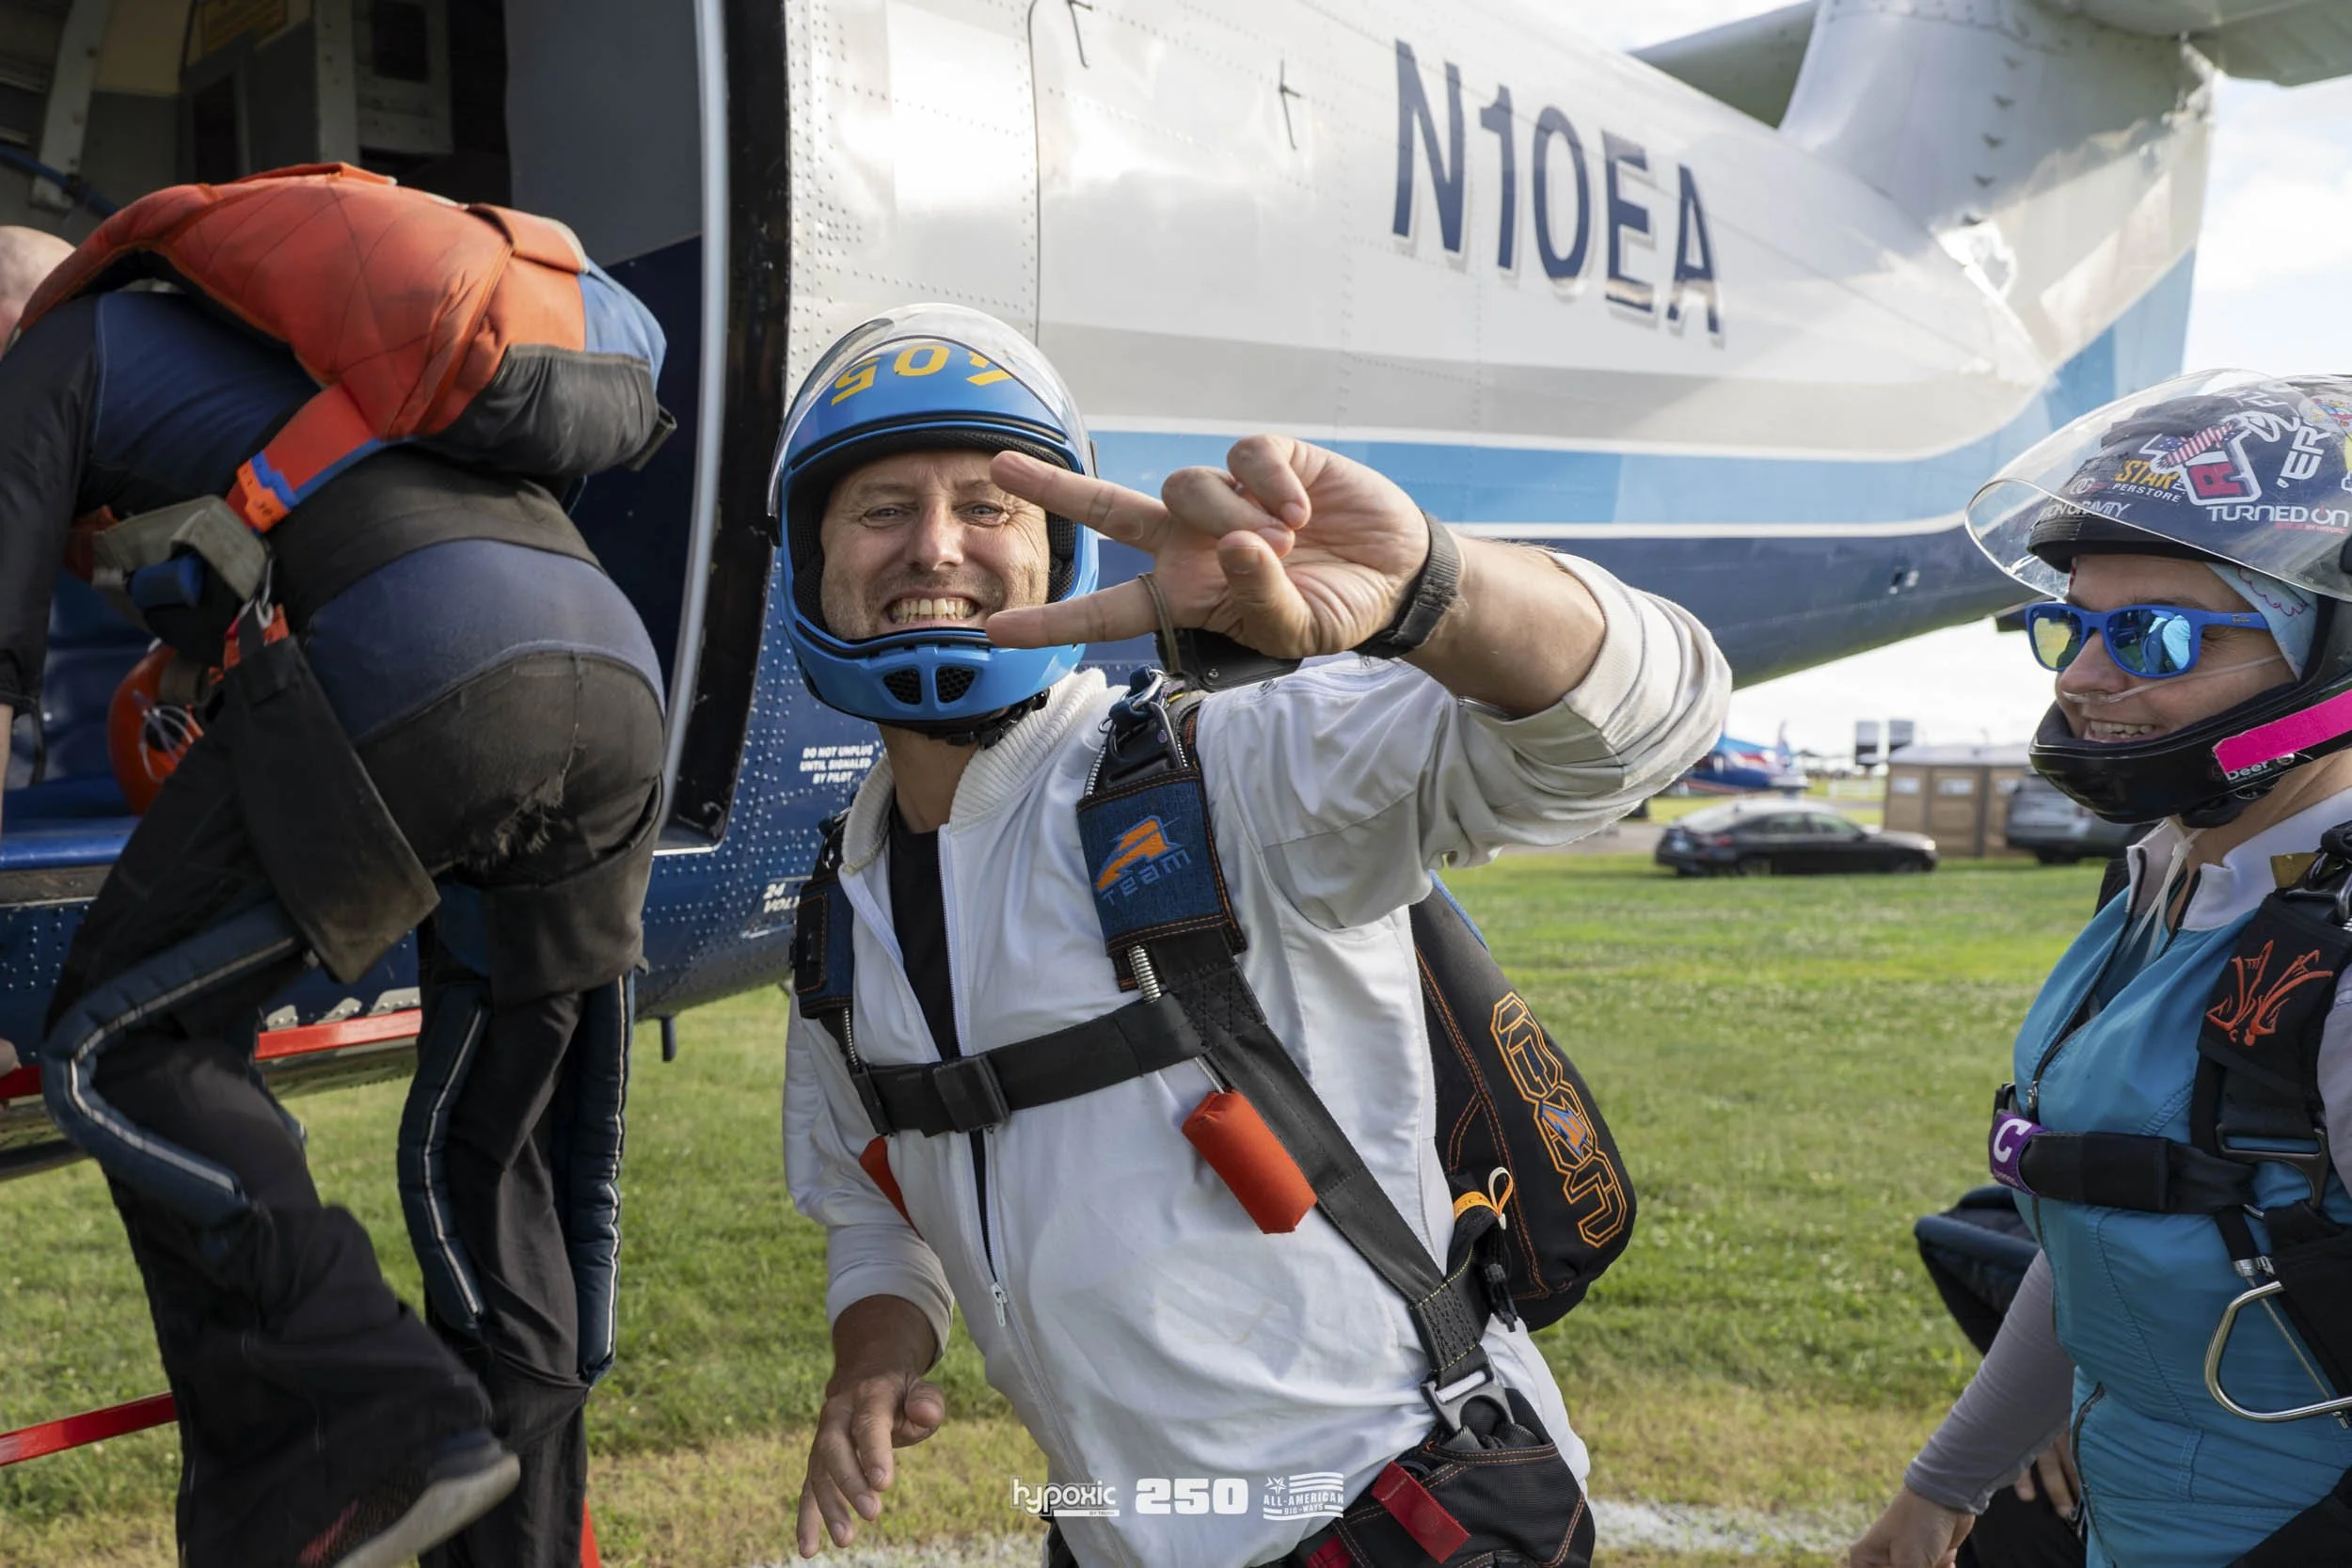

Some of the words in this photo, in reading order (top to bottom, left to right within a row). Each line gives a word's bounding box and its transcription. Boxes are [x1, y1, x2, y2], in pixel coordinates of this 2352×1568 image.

[1392, 38, 1722, 337] N10EA
[818, 747, 837, 758] NOT
[800, 760, 826, 772] UNTIL
[812, 772, 827, 784] BY
[826, 771, 853, 783] PILOT
[763, 882, 787, 899] 24
